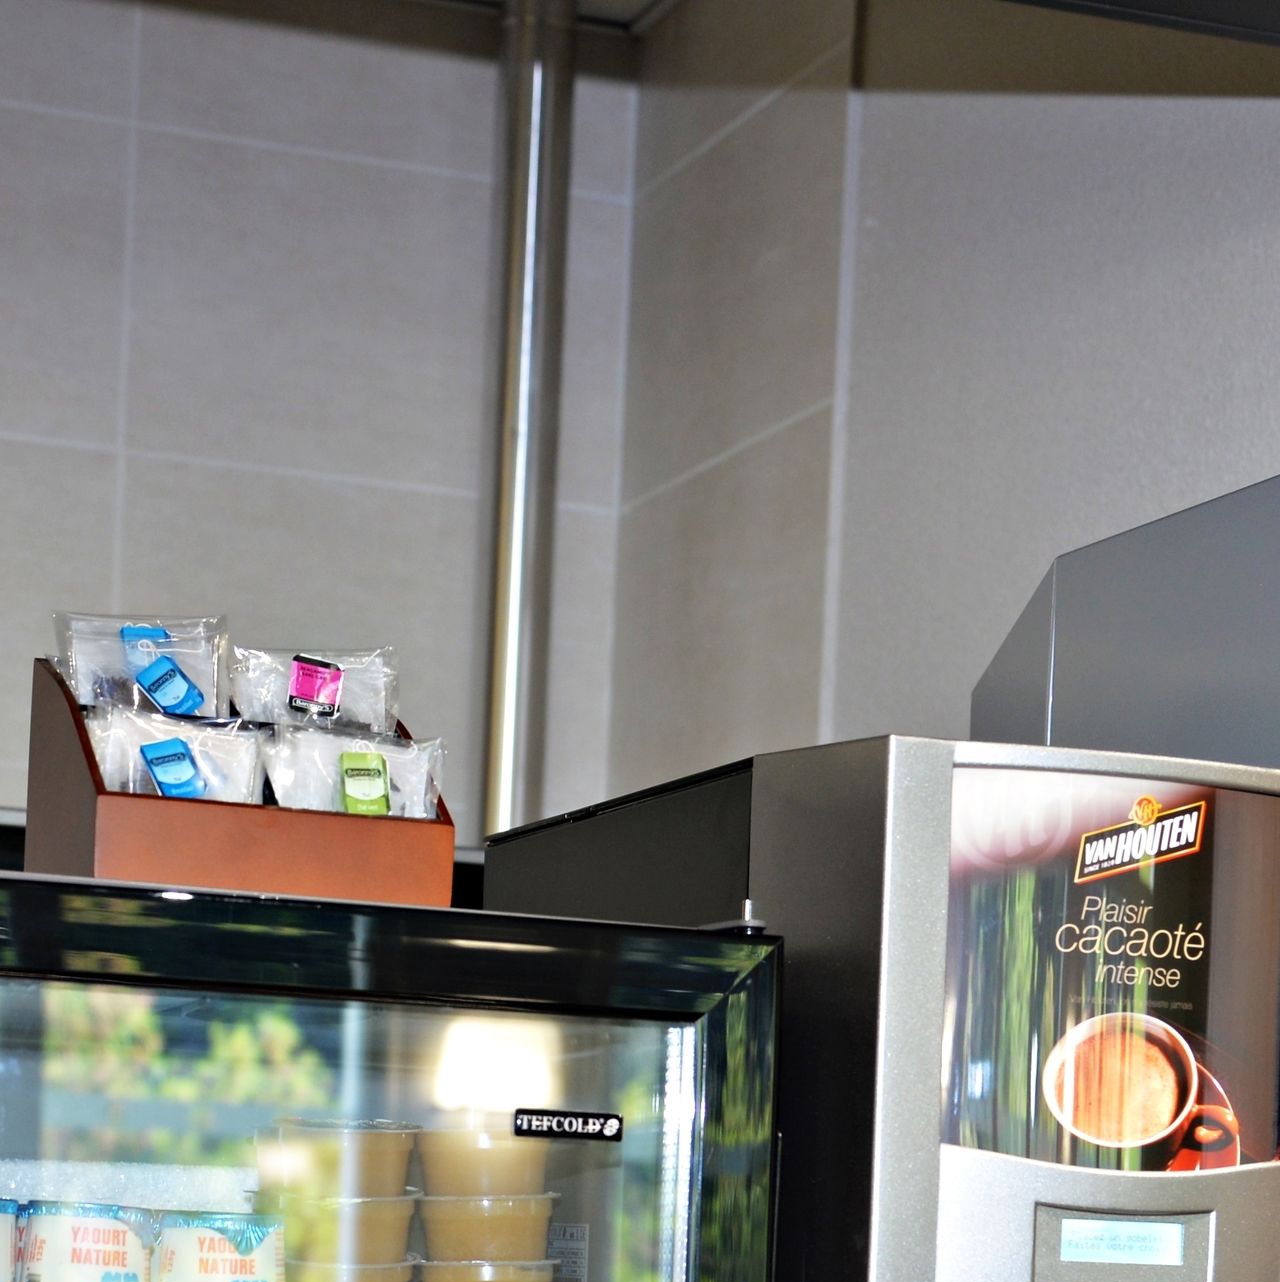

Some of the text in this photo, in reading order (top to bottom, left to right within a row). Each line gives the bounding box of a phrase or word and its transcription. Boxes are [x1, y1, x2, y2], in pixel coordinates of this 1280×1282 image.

[1085, 811, 1198, 865] VAN HOUTEN
[1081, 896, 1154, 924] Plaisir
[1055, 922, 1205, 961] cacaoté
[1095, 959, 1181, 988] intense
[519, 1114, 602, 1134] TEFCOLD
[71, 1226, 128, 1247] YAOURT
[71, 1248, 128, 1268] NATURE
[198, 1258, 256, 1276] NATURE
